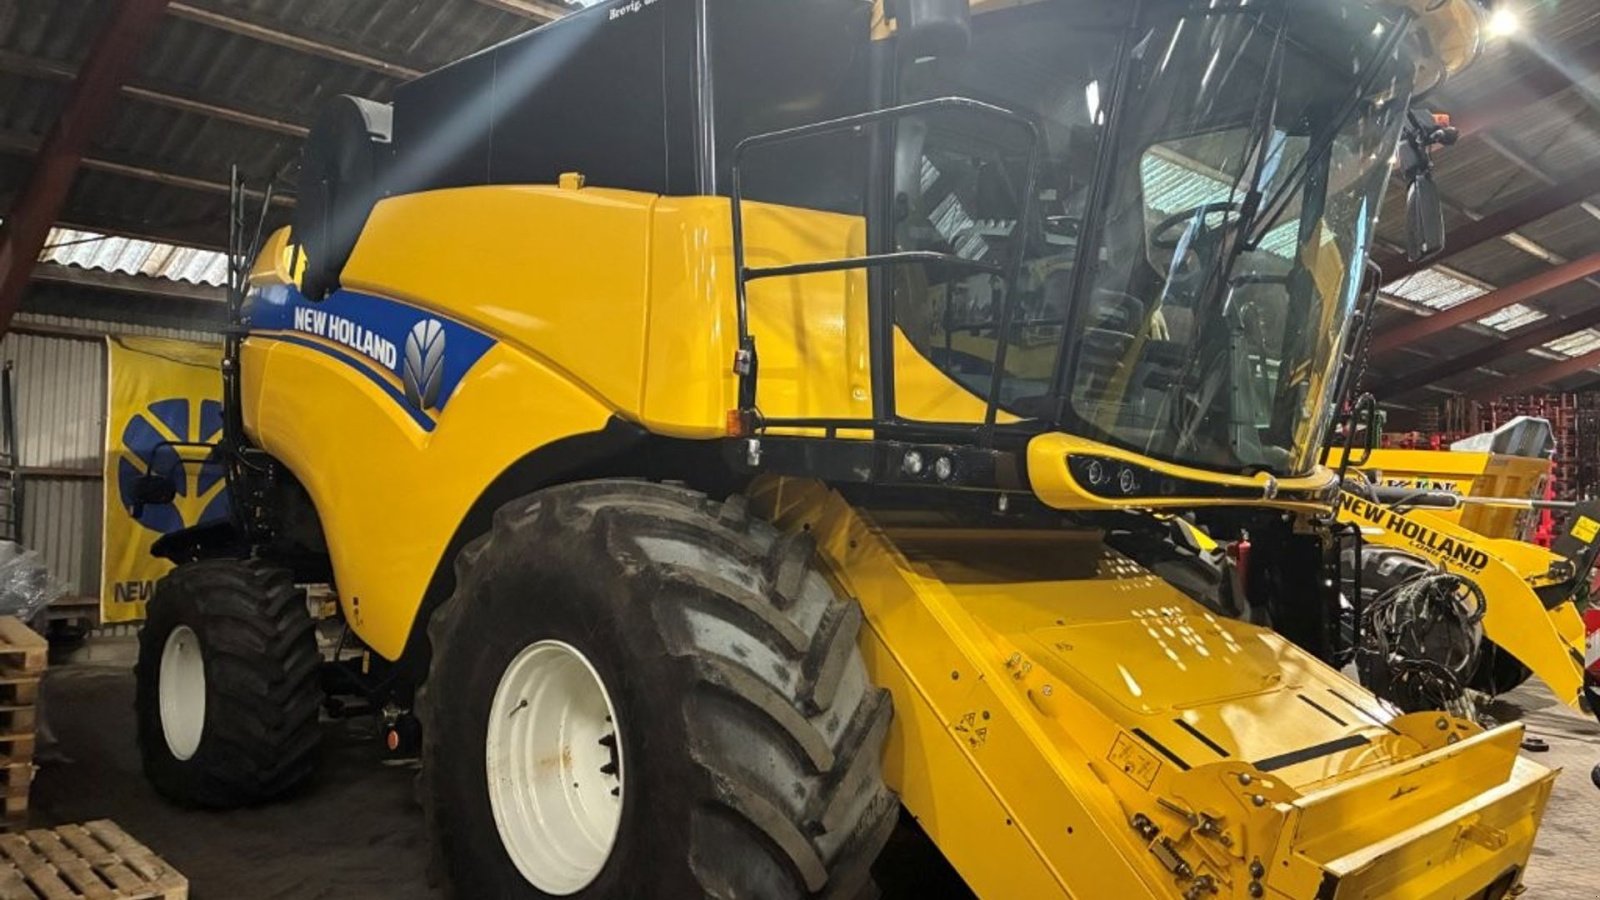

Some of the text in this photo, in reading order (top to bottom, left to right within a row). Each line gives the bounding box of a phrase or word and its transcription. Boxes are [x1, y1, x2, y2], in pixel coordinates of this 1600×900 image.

[294, 306, 397, 370] NEW HOLLAND
[1339, 492, 1489, 570] NEW HOLLAND
